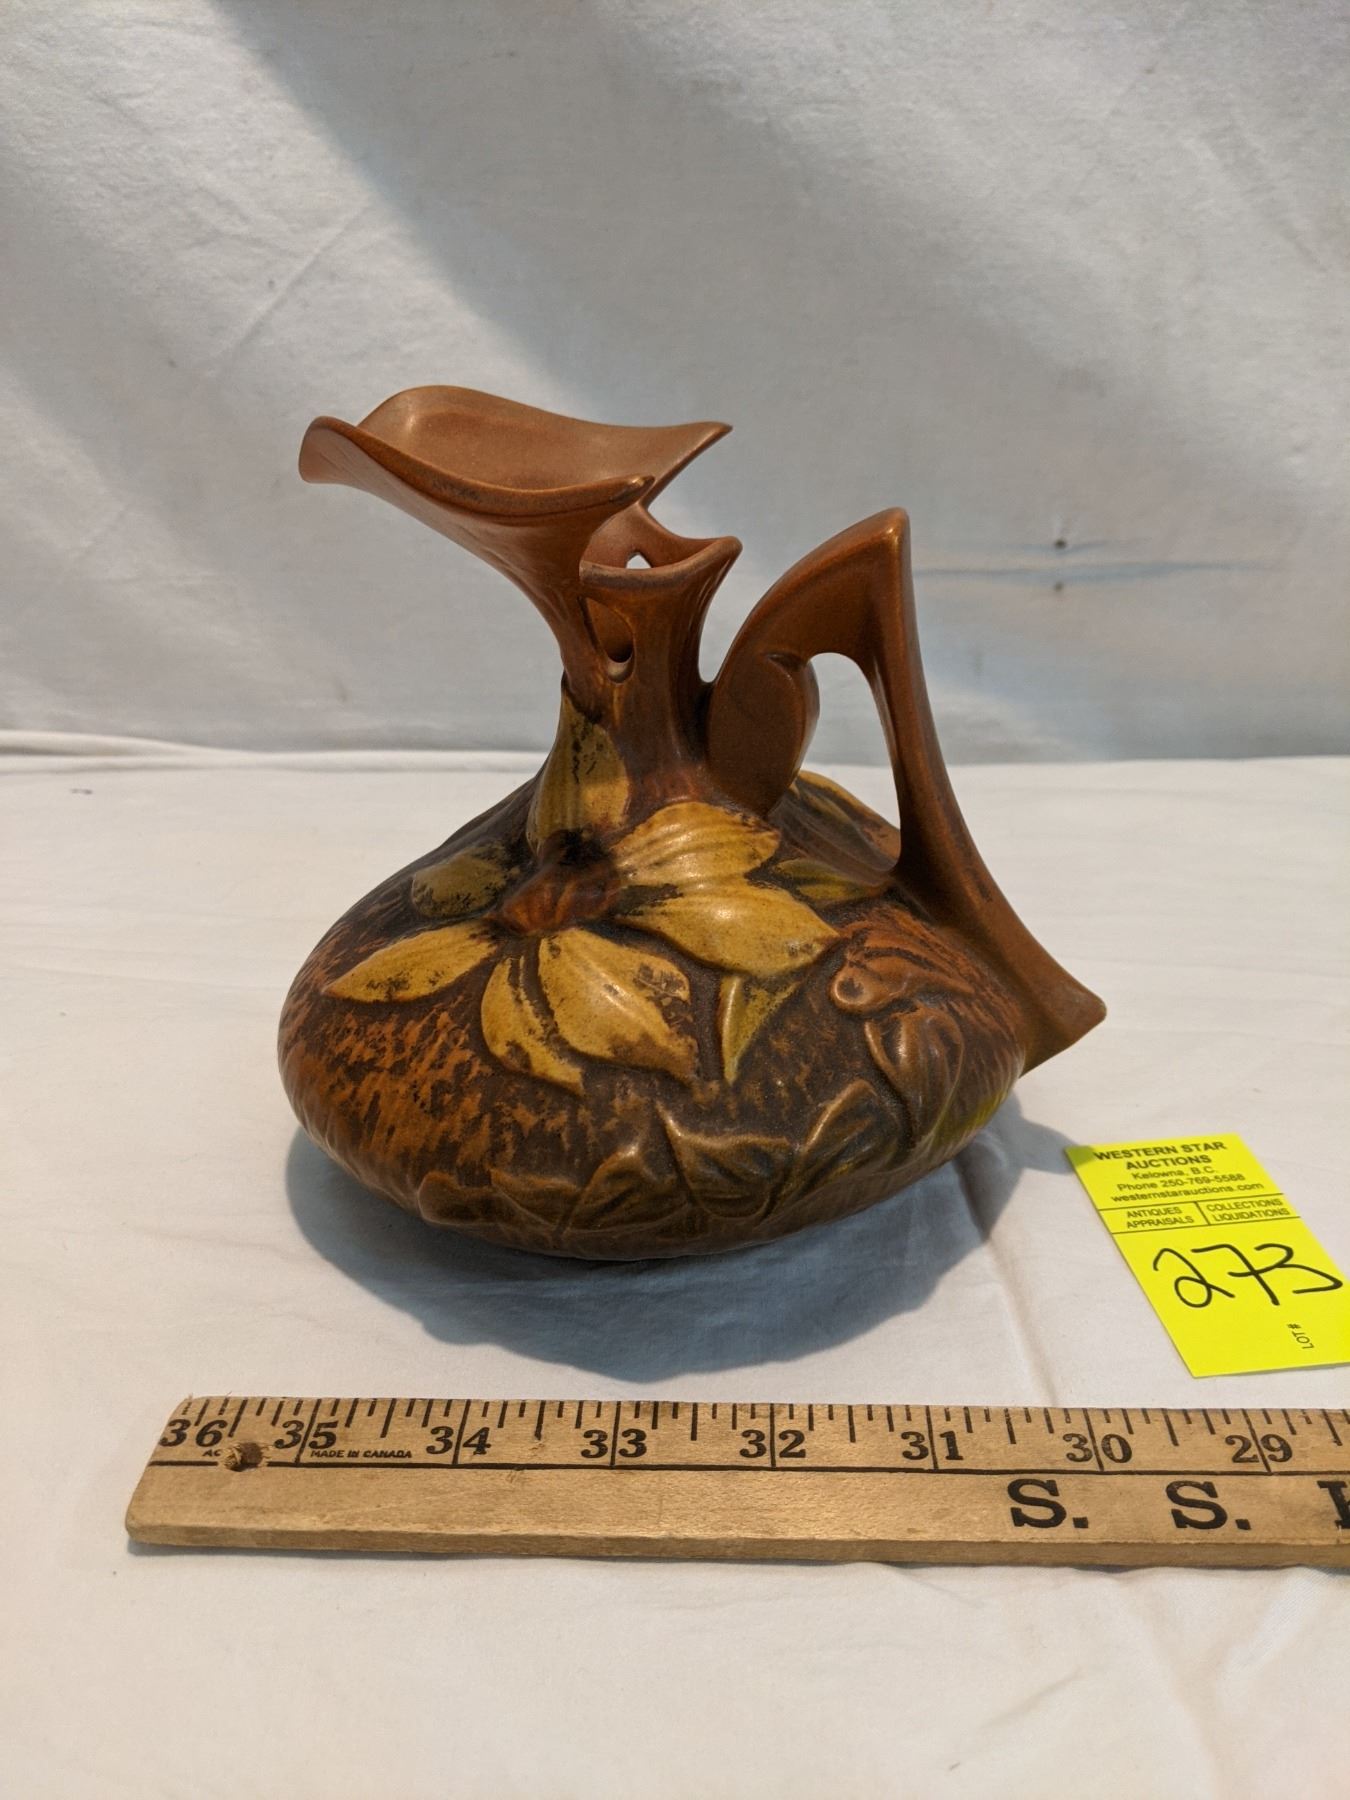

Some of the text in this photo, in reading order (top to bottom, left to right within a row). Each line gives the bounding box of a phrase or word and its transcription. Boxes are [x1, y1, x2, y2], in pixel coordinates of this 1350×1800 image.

[1094, 1141, 1227, 1161] WESTERN STAR
[1126, 1154, 1212, 1170] AUCTIONS
[1111, 1182, 1264, 1202] westernstarauctions.com
[1117, 1173, 1246, 1192] Phone 250-769-5588
[1126, 1206, 1182, 1219] ANTIQUES
[1207, 1198, 1283, 1213] COLLECTIONS
[1212, 1207, 1290, 1222] LIQUIDATIONS
[1126, 1215, 1194, 1229] APPRAISALS
[160, 1419, 228, 1448] 36
[273, 1419, 340, 1450] 35
[425, 1426, 492, 1456] 34
[580, 1428, 648, 1459] 33
[739, 1429, 806, 1459] 32
[310, 1449, 413, 1460] MADE IN CANADA
[900, 1431, 964, 1461] 31
[1062, 1432, 1133, 1464] 30
[1224, 1433, 1294, 1464] 29
[1007, 1478, 1252, 1531] S. S.
